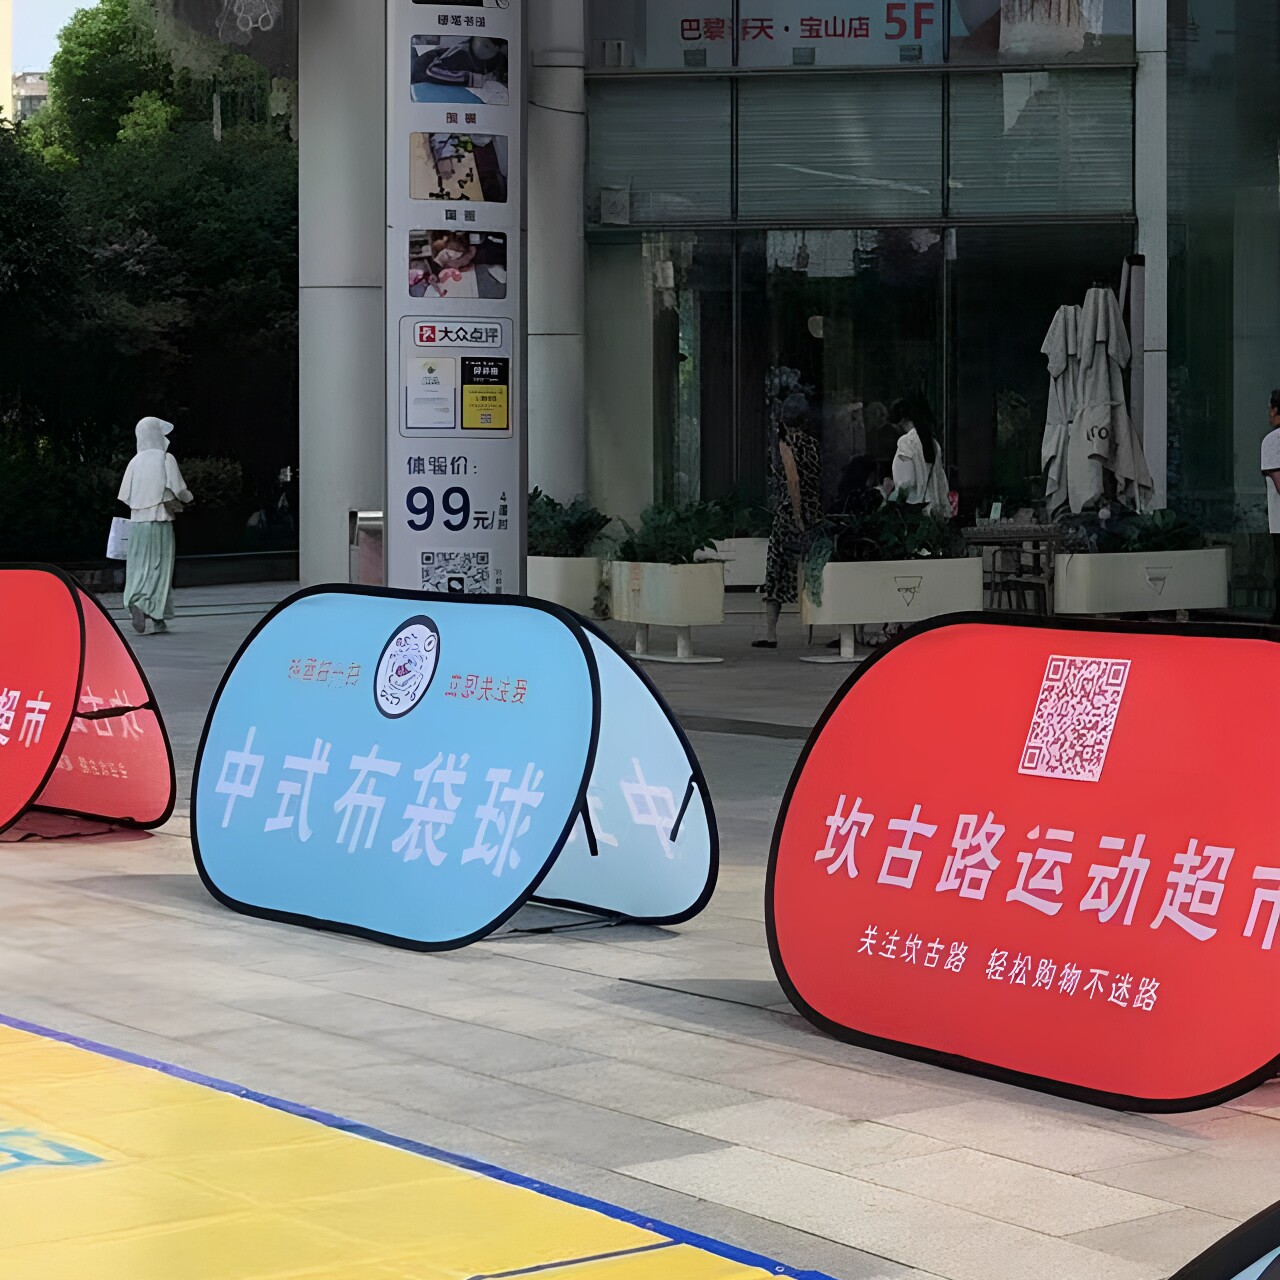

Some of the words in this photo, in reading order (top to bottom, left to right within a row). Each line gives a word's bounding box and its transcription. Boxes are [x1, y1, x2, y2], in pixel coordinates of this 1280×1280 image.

[884, 2, 935, 40] 5F
[215, 726, 544, 878] 中式布袋球
[857, 923, 969, 973] 关注坎古路
[985, 947, 1162, 1011] 轻松购物不迷路
